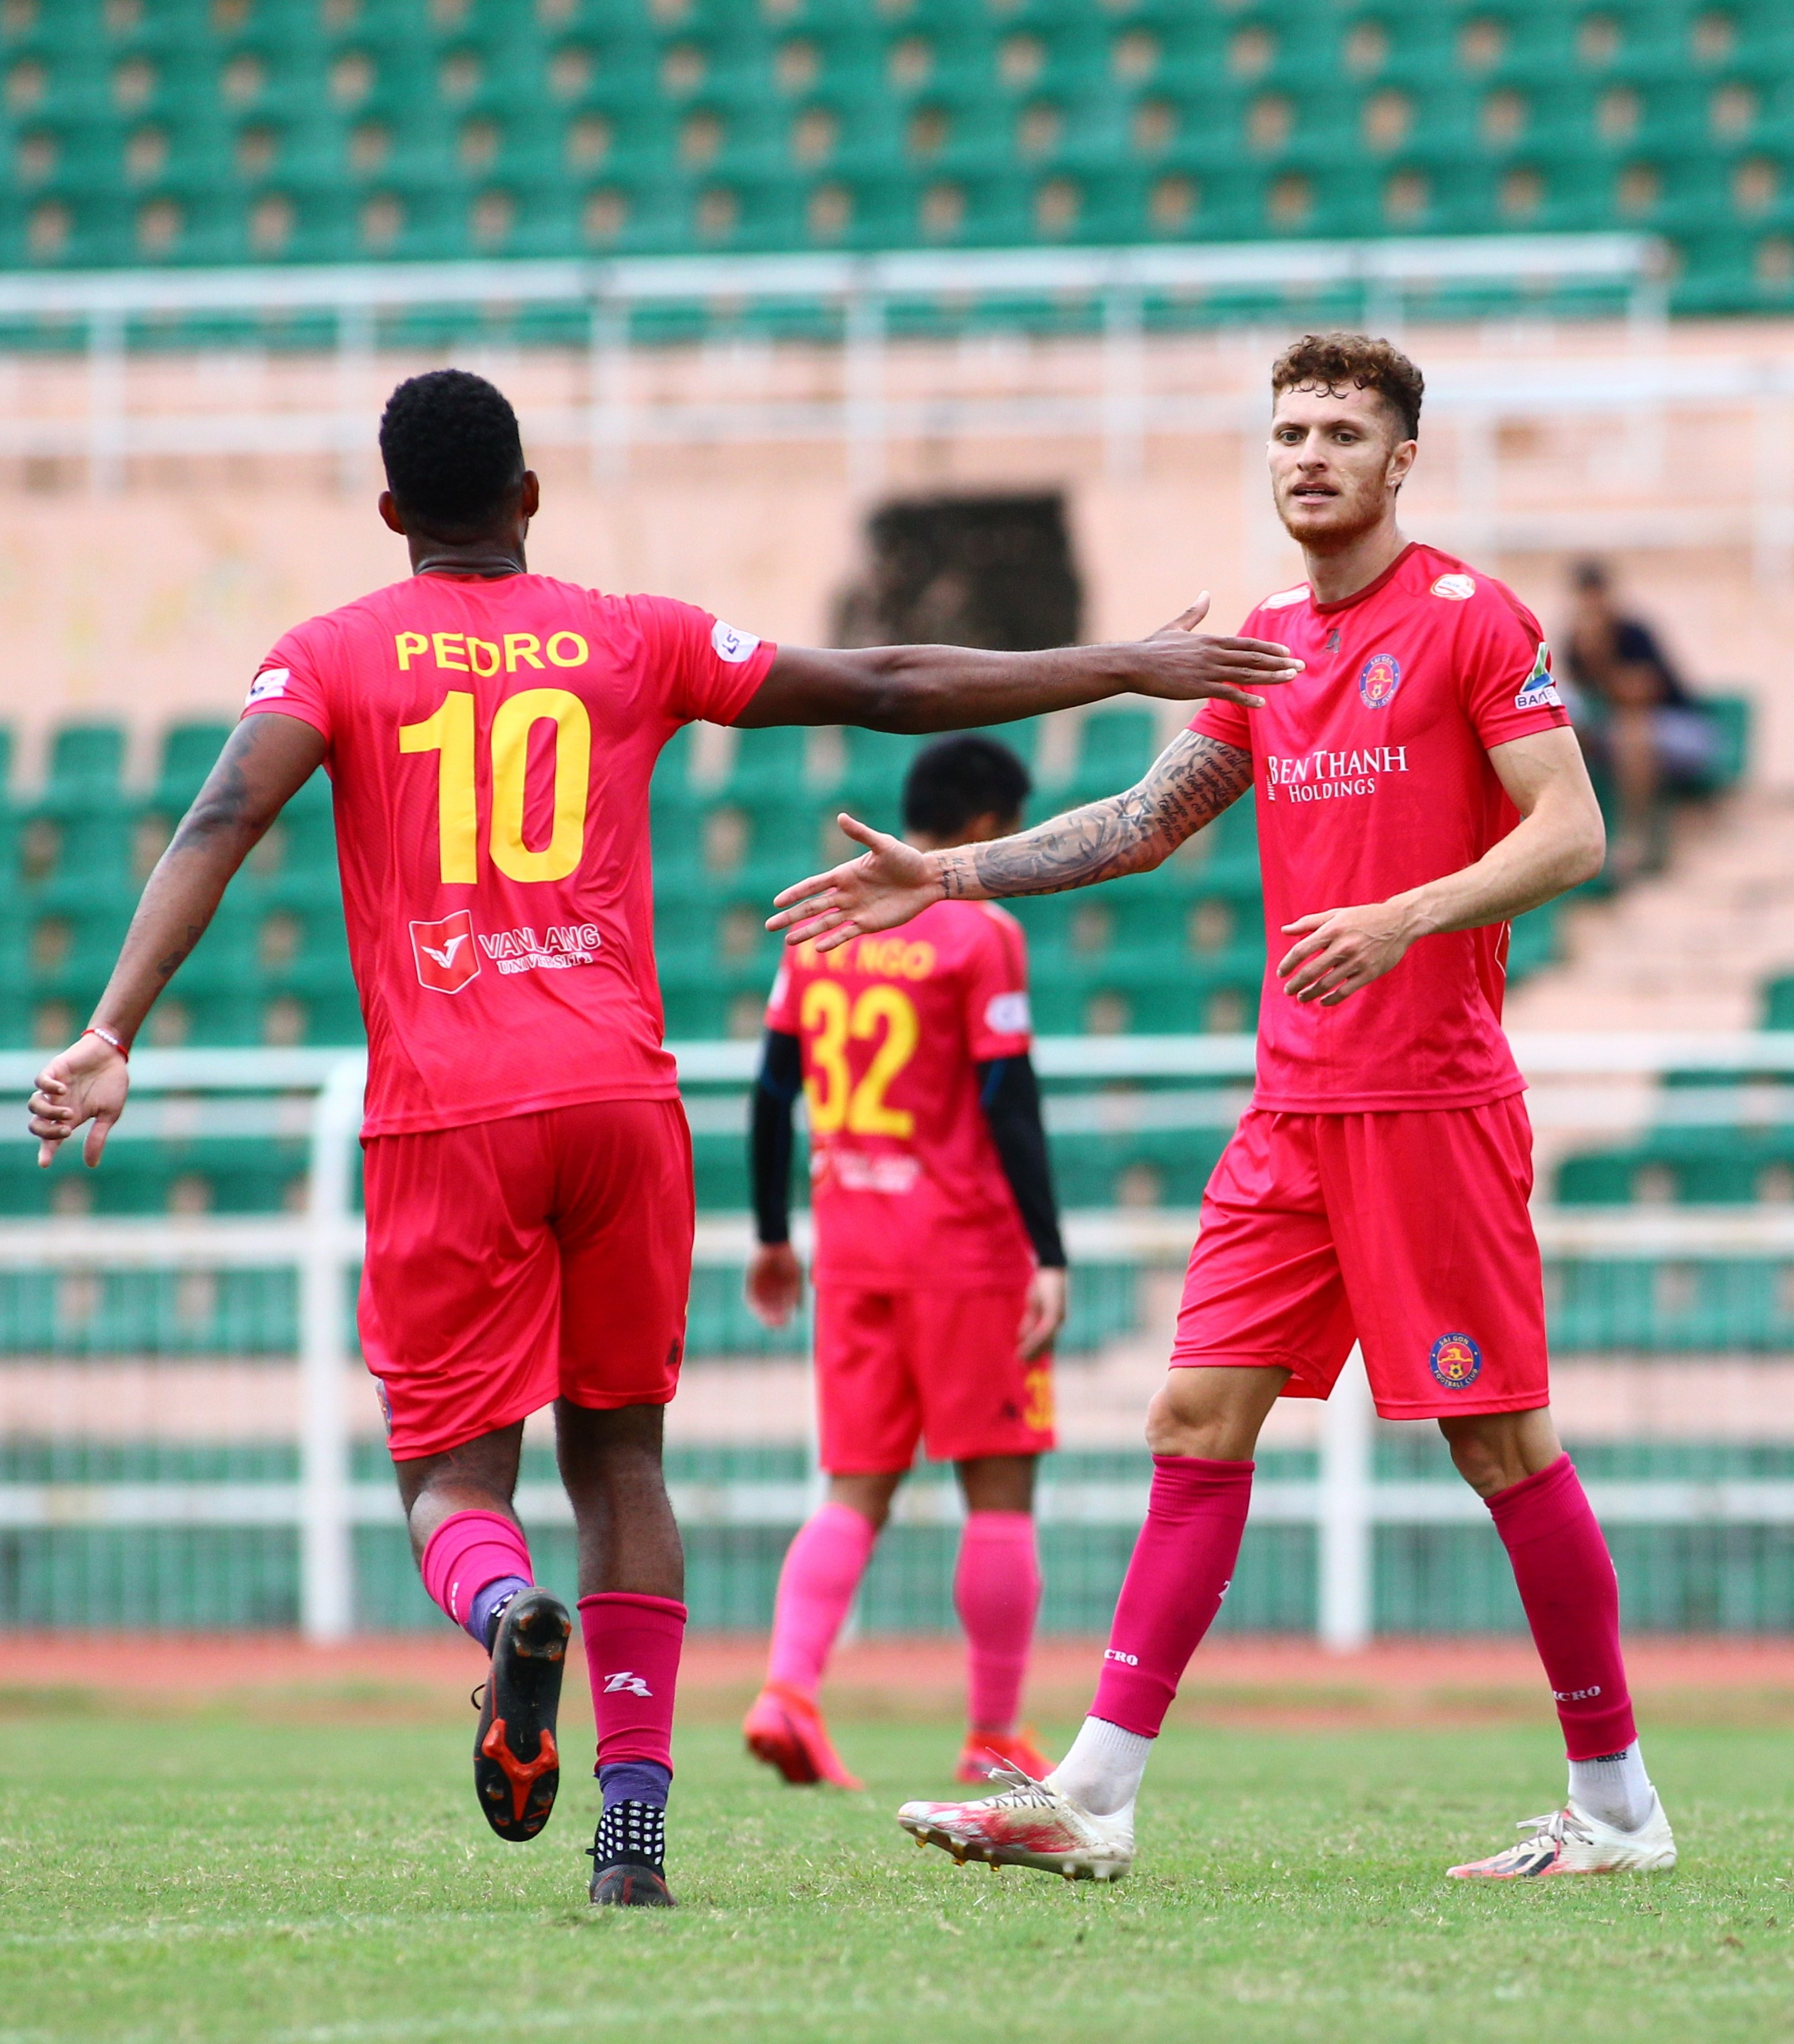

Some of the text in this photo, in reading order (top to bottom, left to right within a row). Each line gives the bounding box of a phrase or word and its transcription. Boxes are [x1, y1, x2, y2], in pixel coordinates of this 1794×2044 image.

[395, 631, 589, 677] PEDRO
[399, 688, 591, 884] 10
[1289, 778, 1375, 803] HOLDINGS
[497, 952, 594, 974] UNIVERSITY
[800, 978, 918, 1140] 32
[1438, 1335, 1469, 1346] SAI GON
[1433, 1368, 1478, 1388] FOOTBALL CLUB
